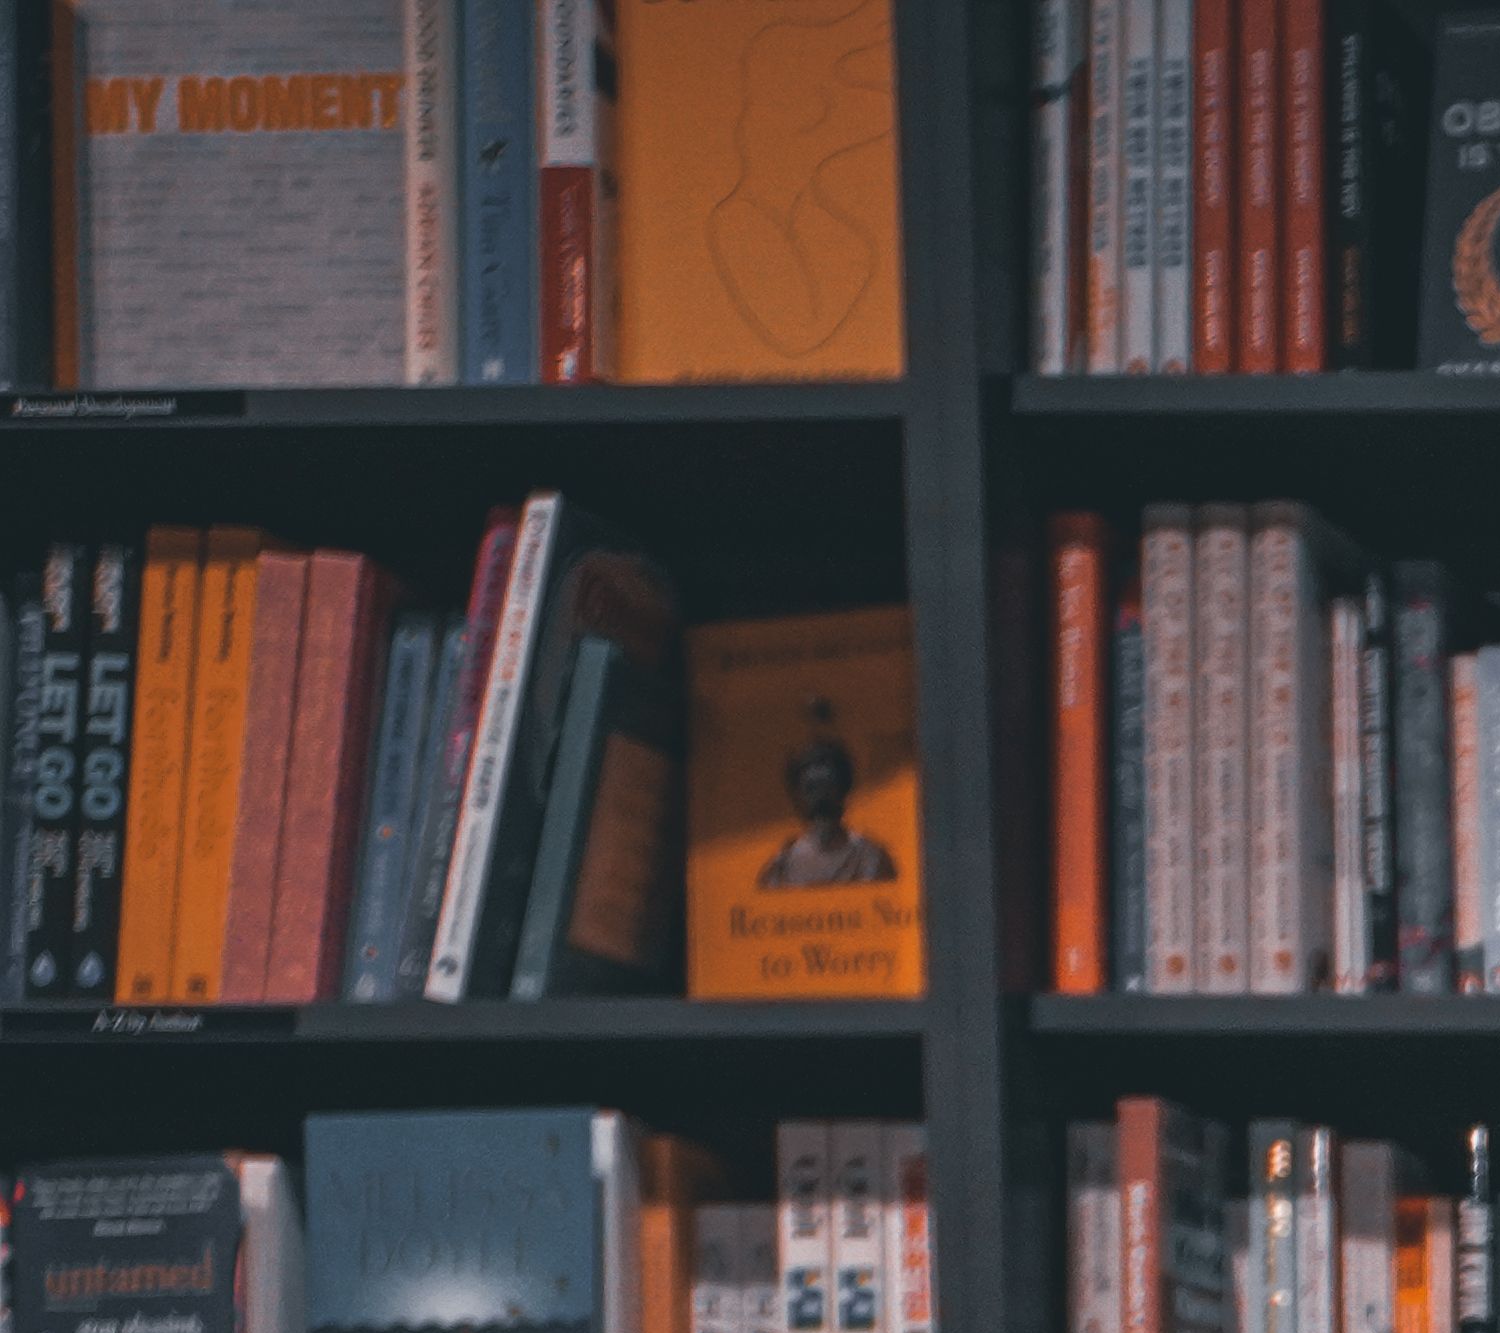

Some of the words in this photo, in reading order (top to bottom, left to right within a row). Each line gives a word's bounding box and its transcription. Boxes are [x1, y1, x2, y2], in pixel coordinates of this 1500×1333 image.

[84, 76, 160, 134] MY
[180, 74, 405, 133] MOMENT
[1459, 143, 1485, 169] IS
[37, 653, 80, 742] LET
[85, 651, 128, 743] LET
[34, 746, 72, 820] GO
[82, 746, 119, 820] GO
[797, 944, 896, 986] Worry
[45, 1251, 214, 1295] untamed
